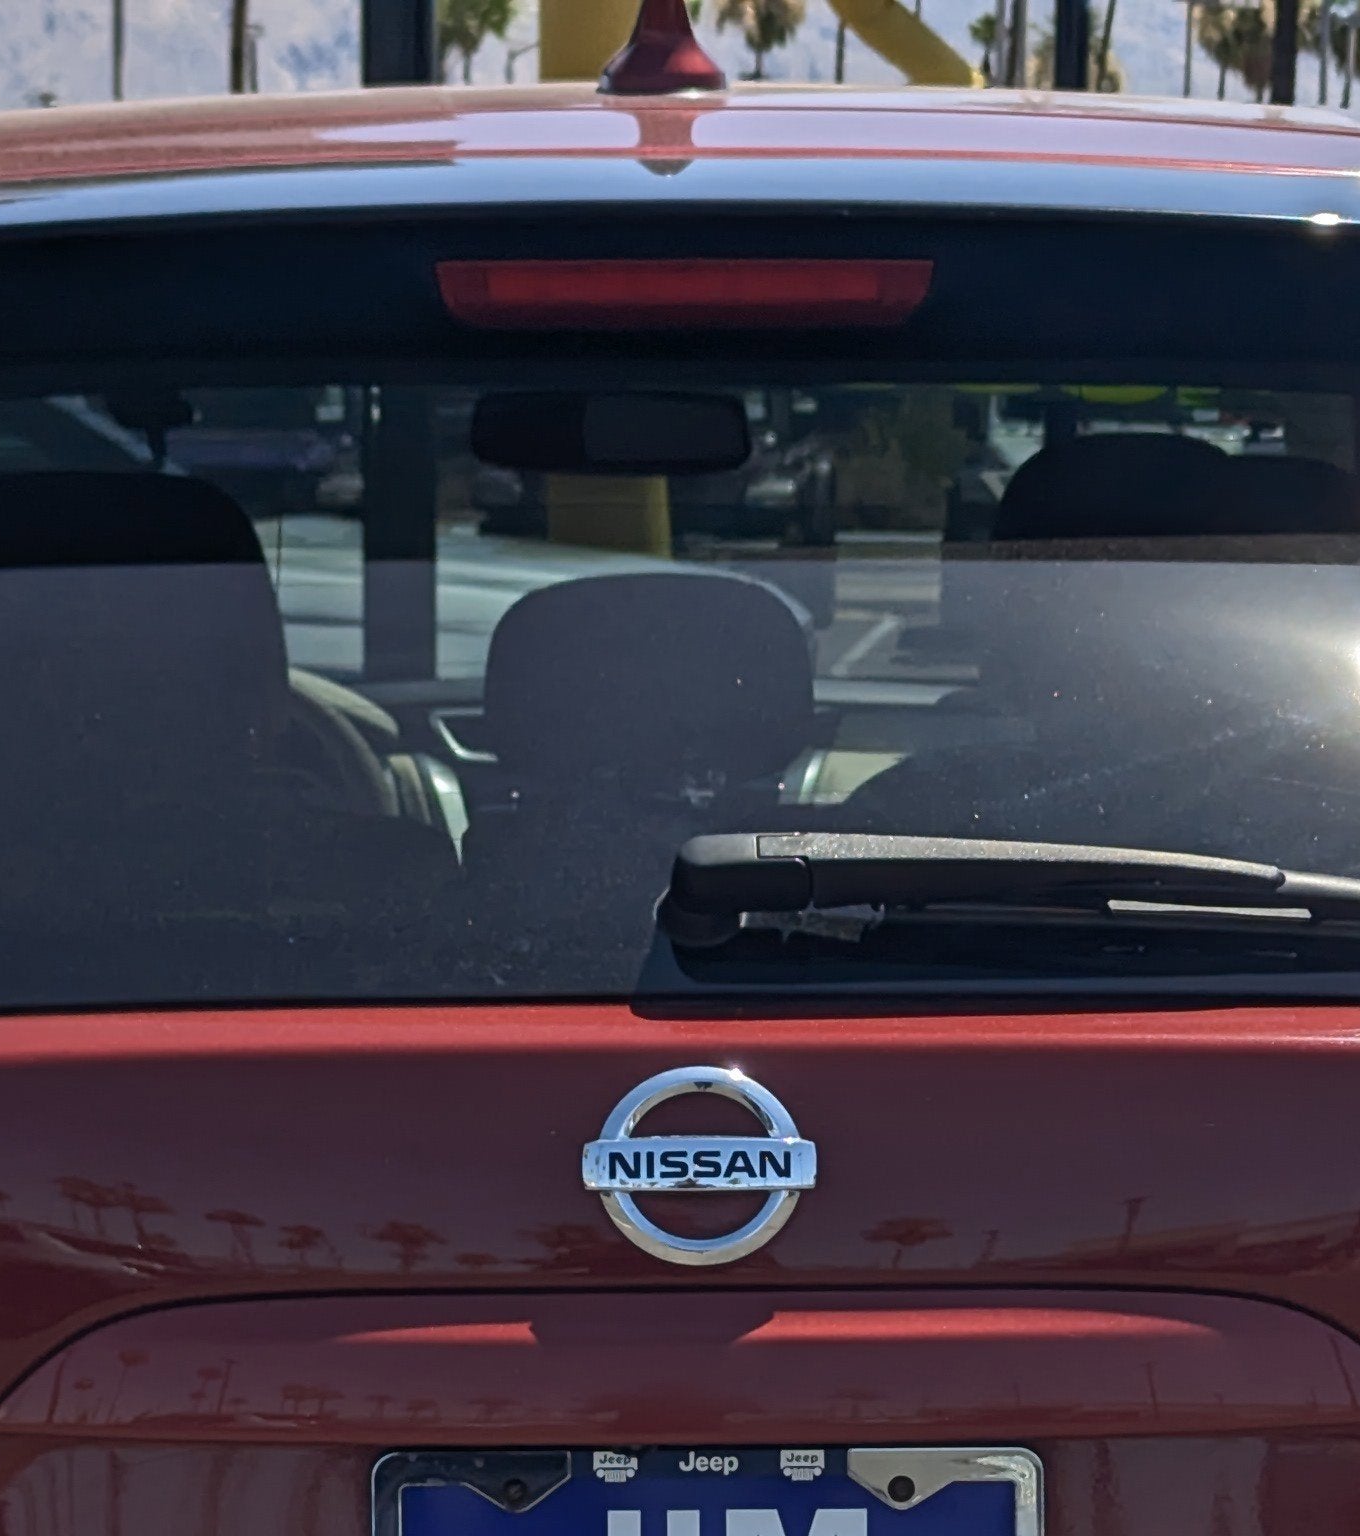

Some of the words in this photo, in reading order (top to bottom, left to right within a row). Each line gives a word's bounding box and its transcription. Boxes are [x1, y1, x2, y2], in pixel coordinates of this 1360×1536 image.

[609, 1151, 791, 1180] NISSAN
[679, 1452, 739, 1475] Jeep
[786, 1452, 819, 1464] Jeep
